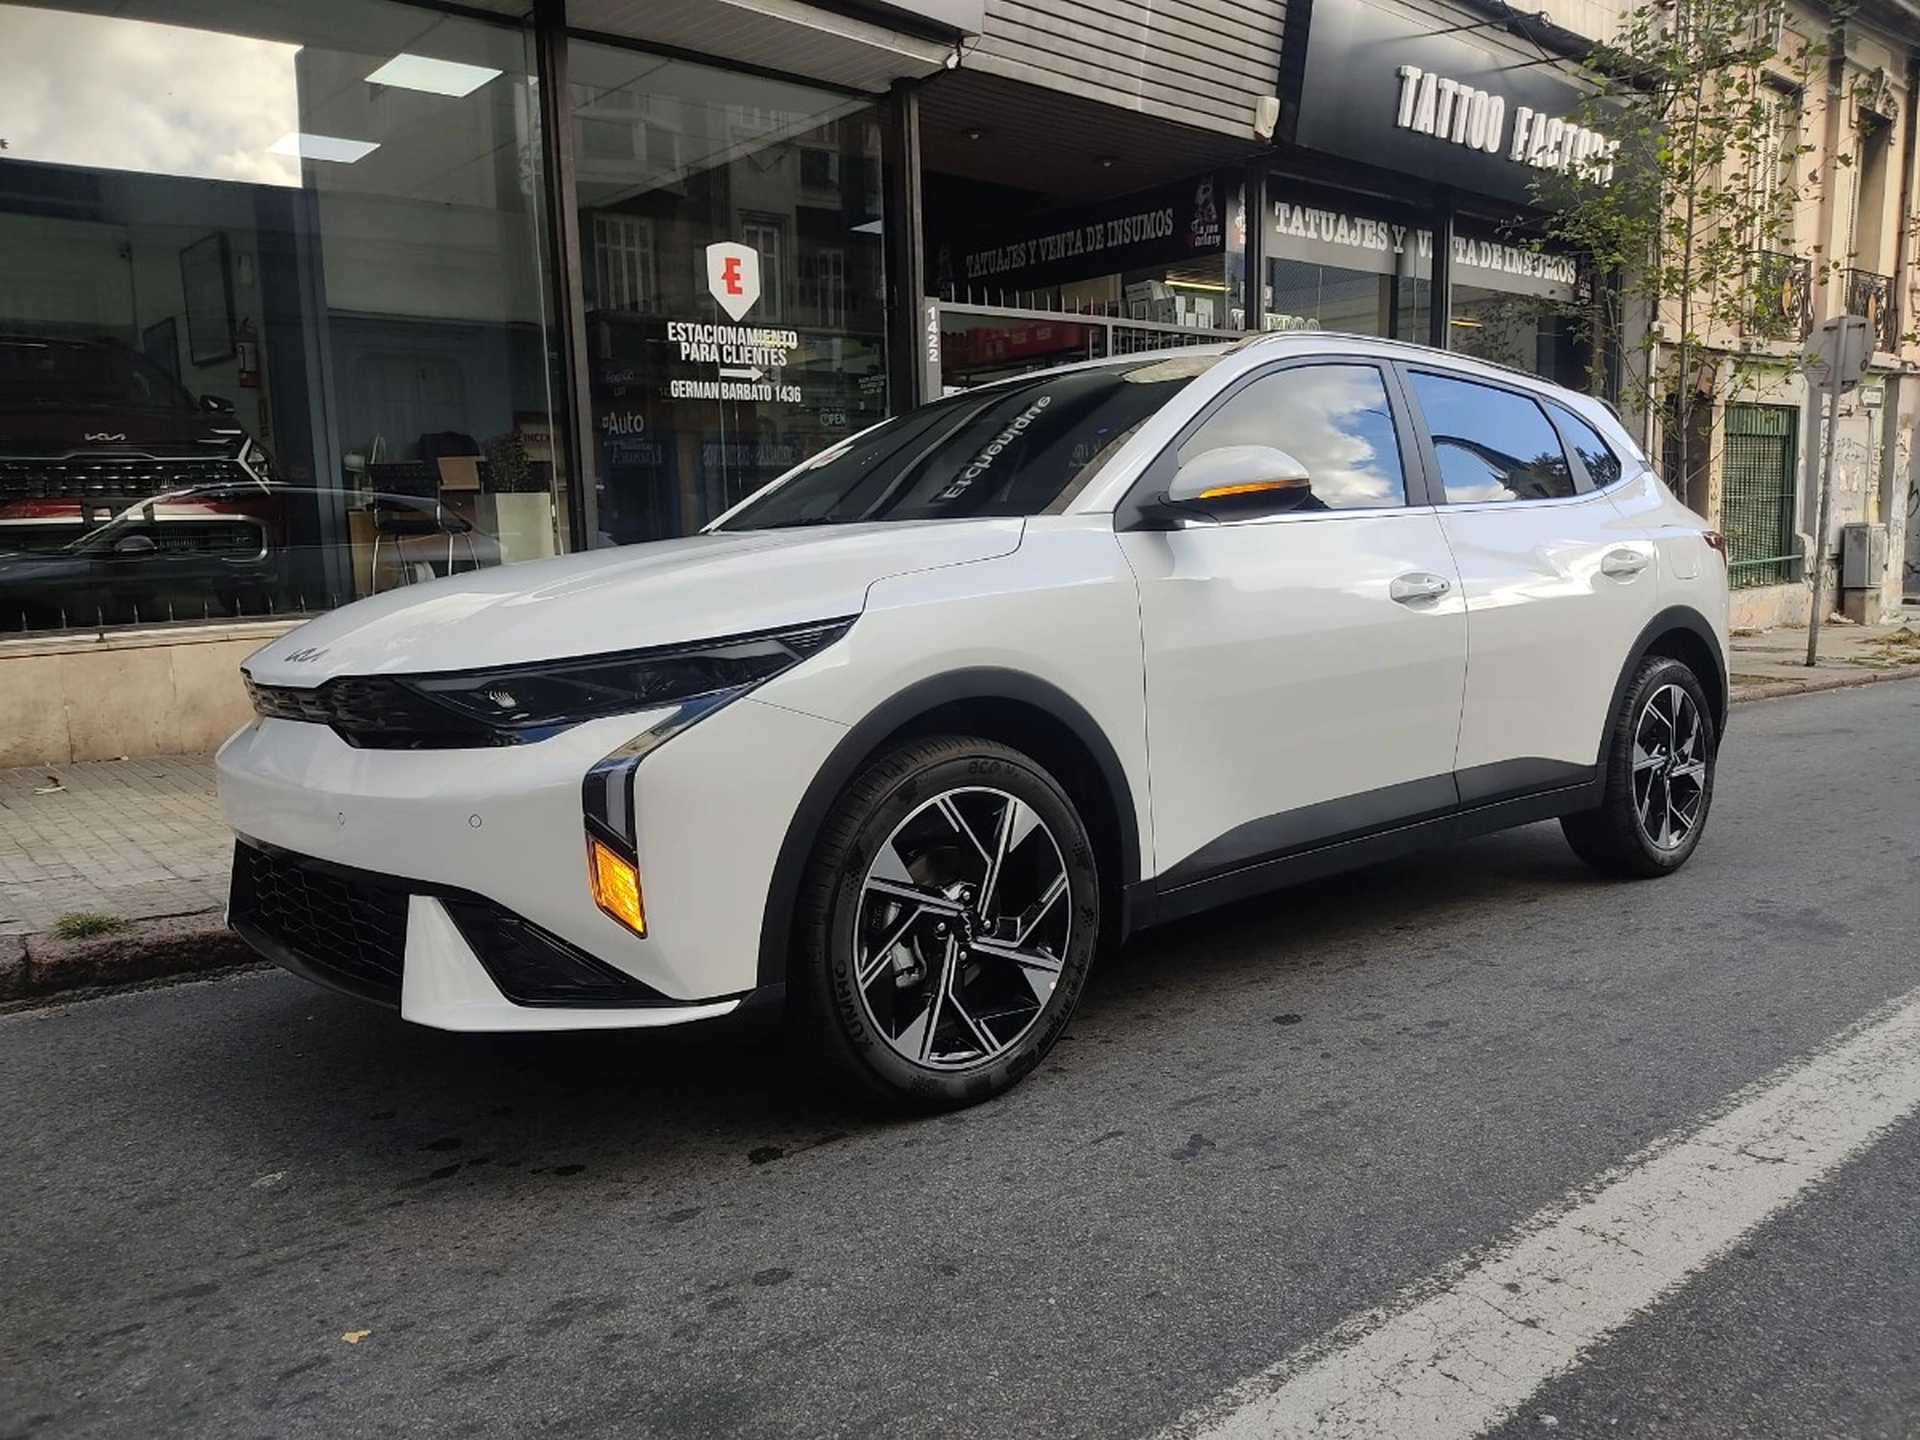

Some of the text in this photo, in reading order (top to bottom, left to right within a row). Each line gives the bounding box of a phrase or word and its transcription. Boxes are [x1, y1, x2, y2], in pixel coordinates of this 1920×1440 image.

[1398, 65, 1504, 153] TATTOO
[966, 208, 1174, 278] TATUAJES Y VENTA DE INSUMOS
[1274, 201, 1388, 251] TATUAJES
[1392, 224, 1406, 253] Y
[1480, 241, 1501, 271] DE
[1503, 246, 1577, 284] INSUMOS
[667, 321, 799, 349] ESTACIONAMIENTO
[680, 341, 788, 366] PARA CLIENTES
[927, 306, 939, 362] 1422
[670, 379, 801, 402] GERMAN BARBATO 1436
[820, 411, 846, 428] OPEN
